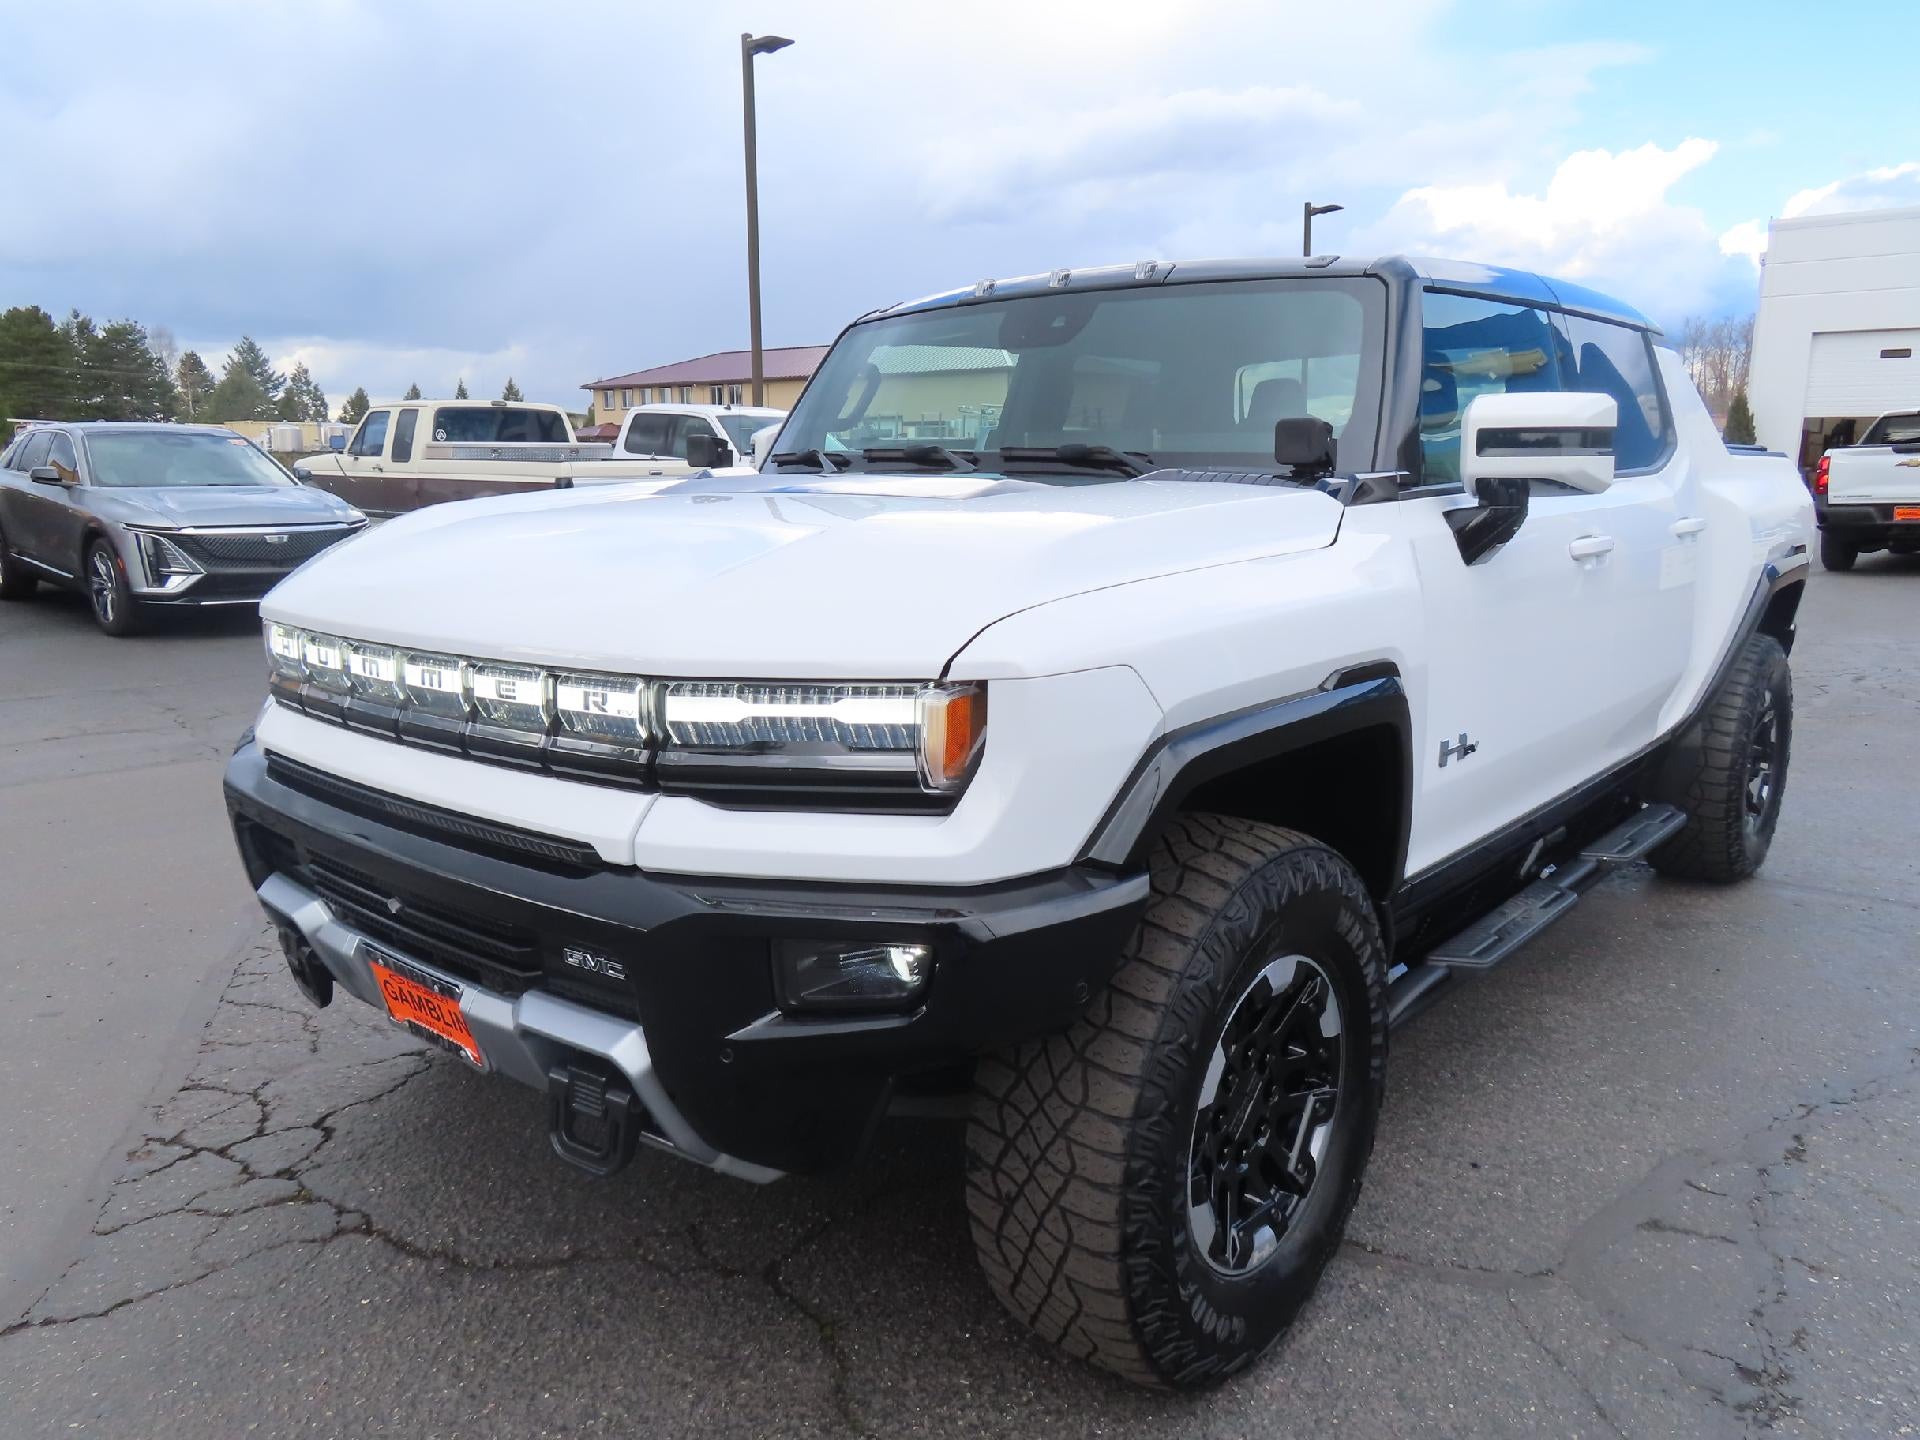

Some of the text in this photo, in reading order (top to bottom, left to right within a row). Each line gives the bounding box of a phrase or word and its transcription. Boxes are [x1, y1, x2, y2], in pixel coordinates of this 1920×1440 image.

[280, 637, 609, 714] HUMMER
[563, 947, 626, 980] GMC
[383, 979, 472, 1037] GAMBLIN
